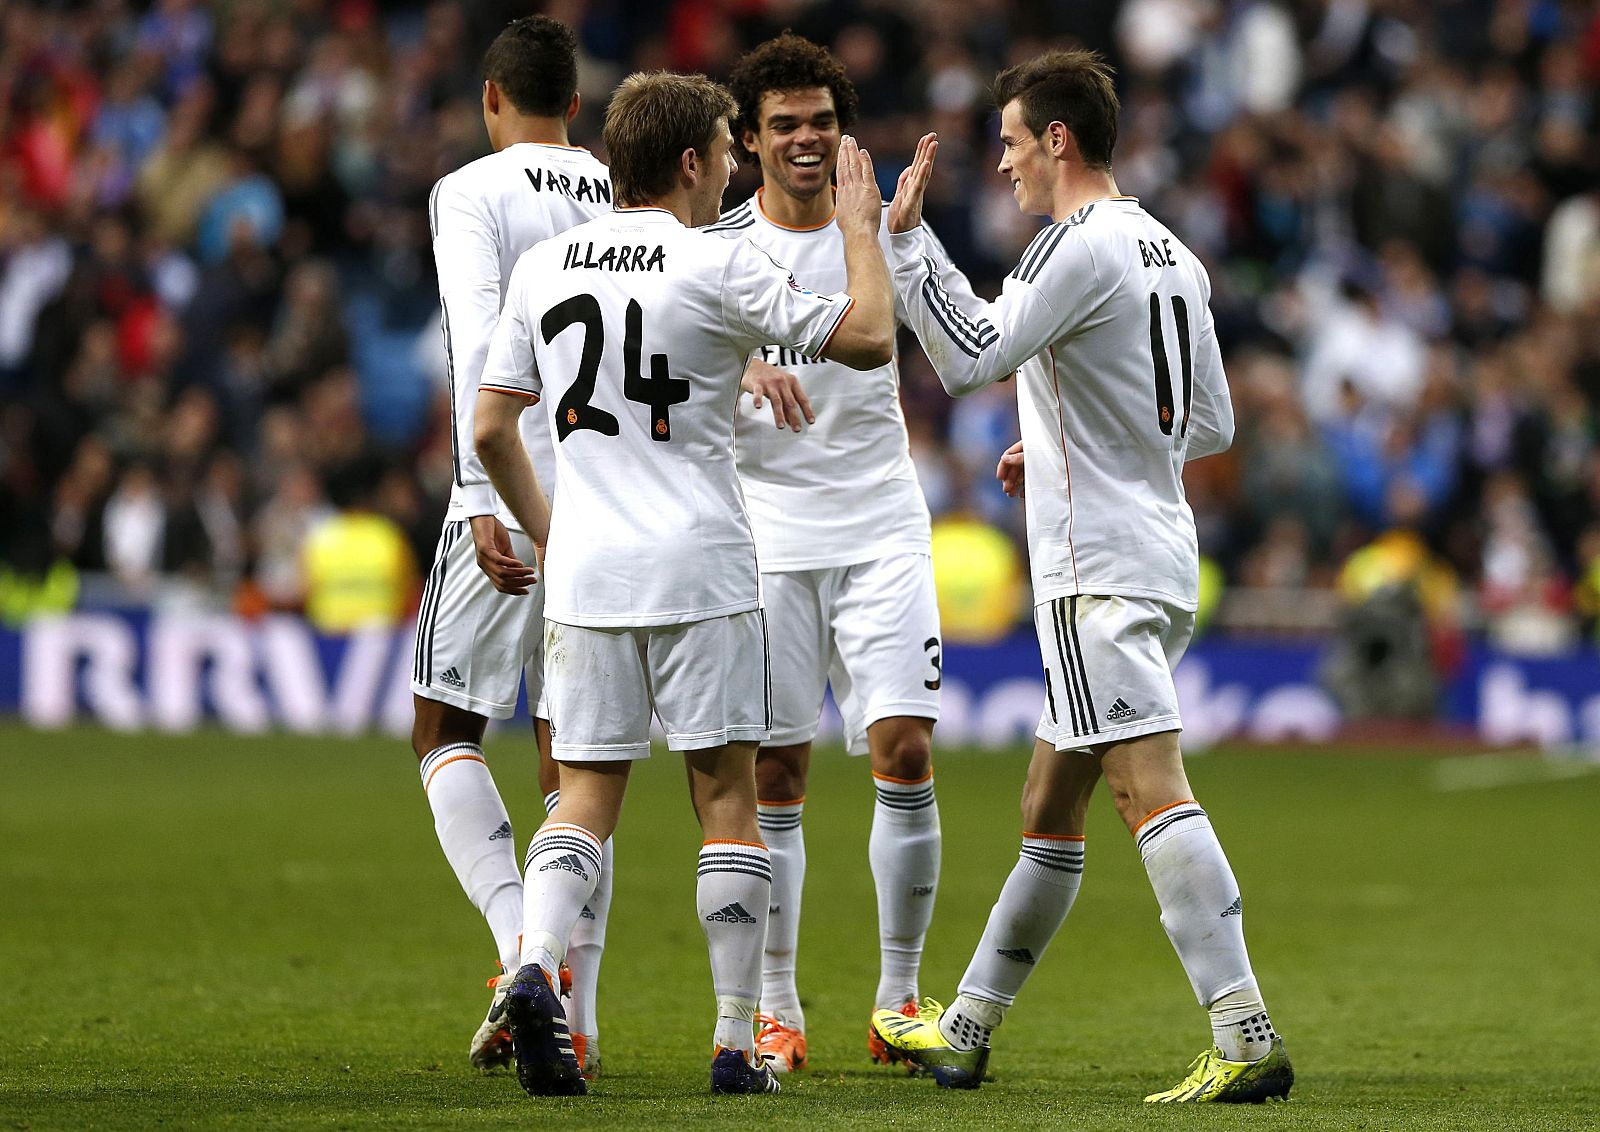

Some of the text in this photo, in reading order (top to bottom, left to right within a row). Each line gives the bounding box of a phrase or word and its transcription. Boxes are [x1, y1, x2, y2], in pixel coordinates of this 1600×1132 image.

[563, 241, 666, 272] ILLARRA
[540, 293, 691, 443] 24
[1149, 291, 1192, 439] 11
[924, 636, 941, 691] 3
[539, 861, 589, 882] adidas
